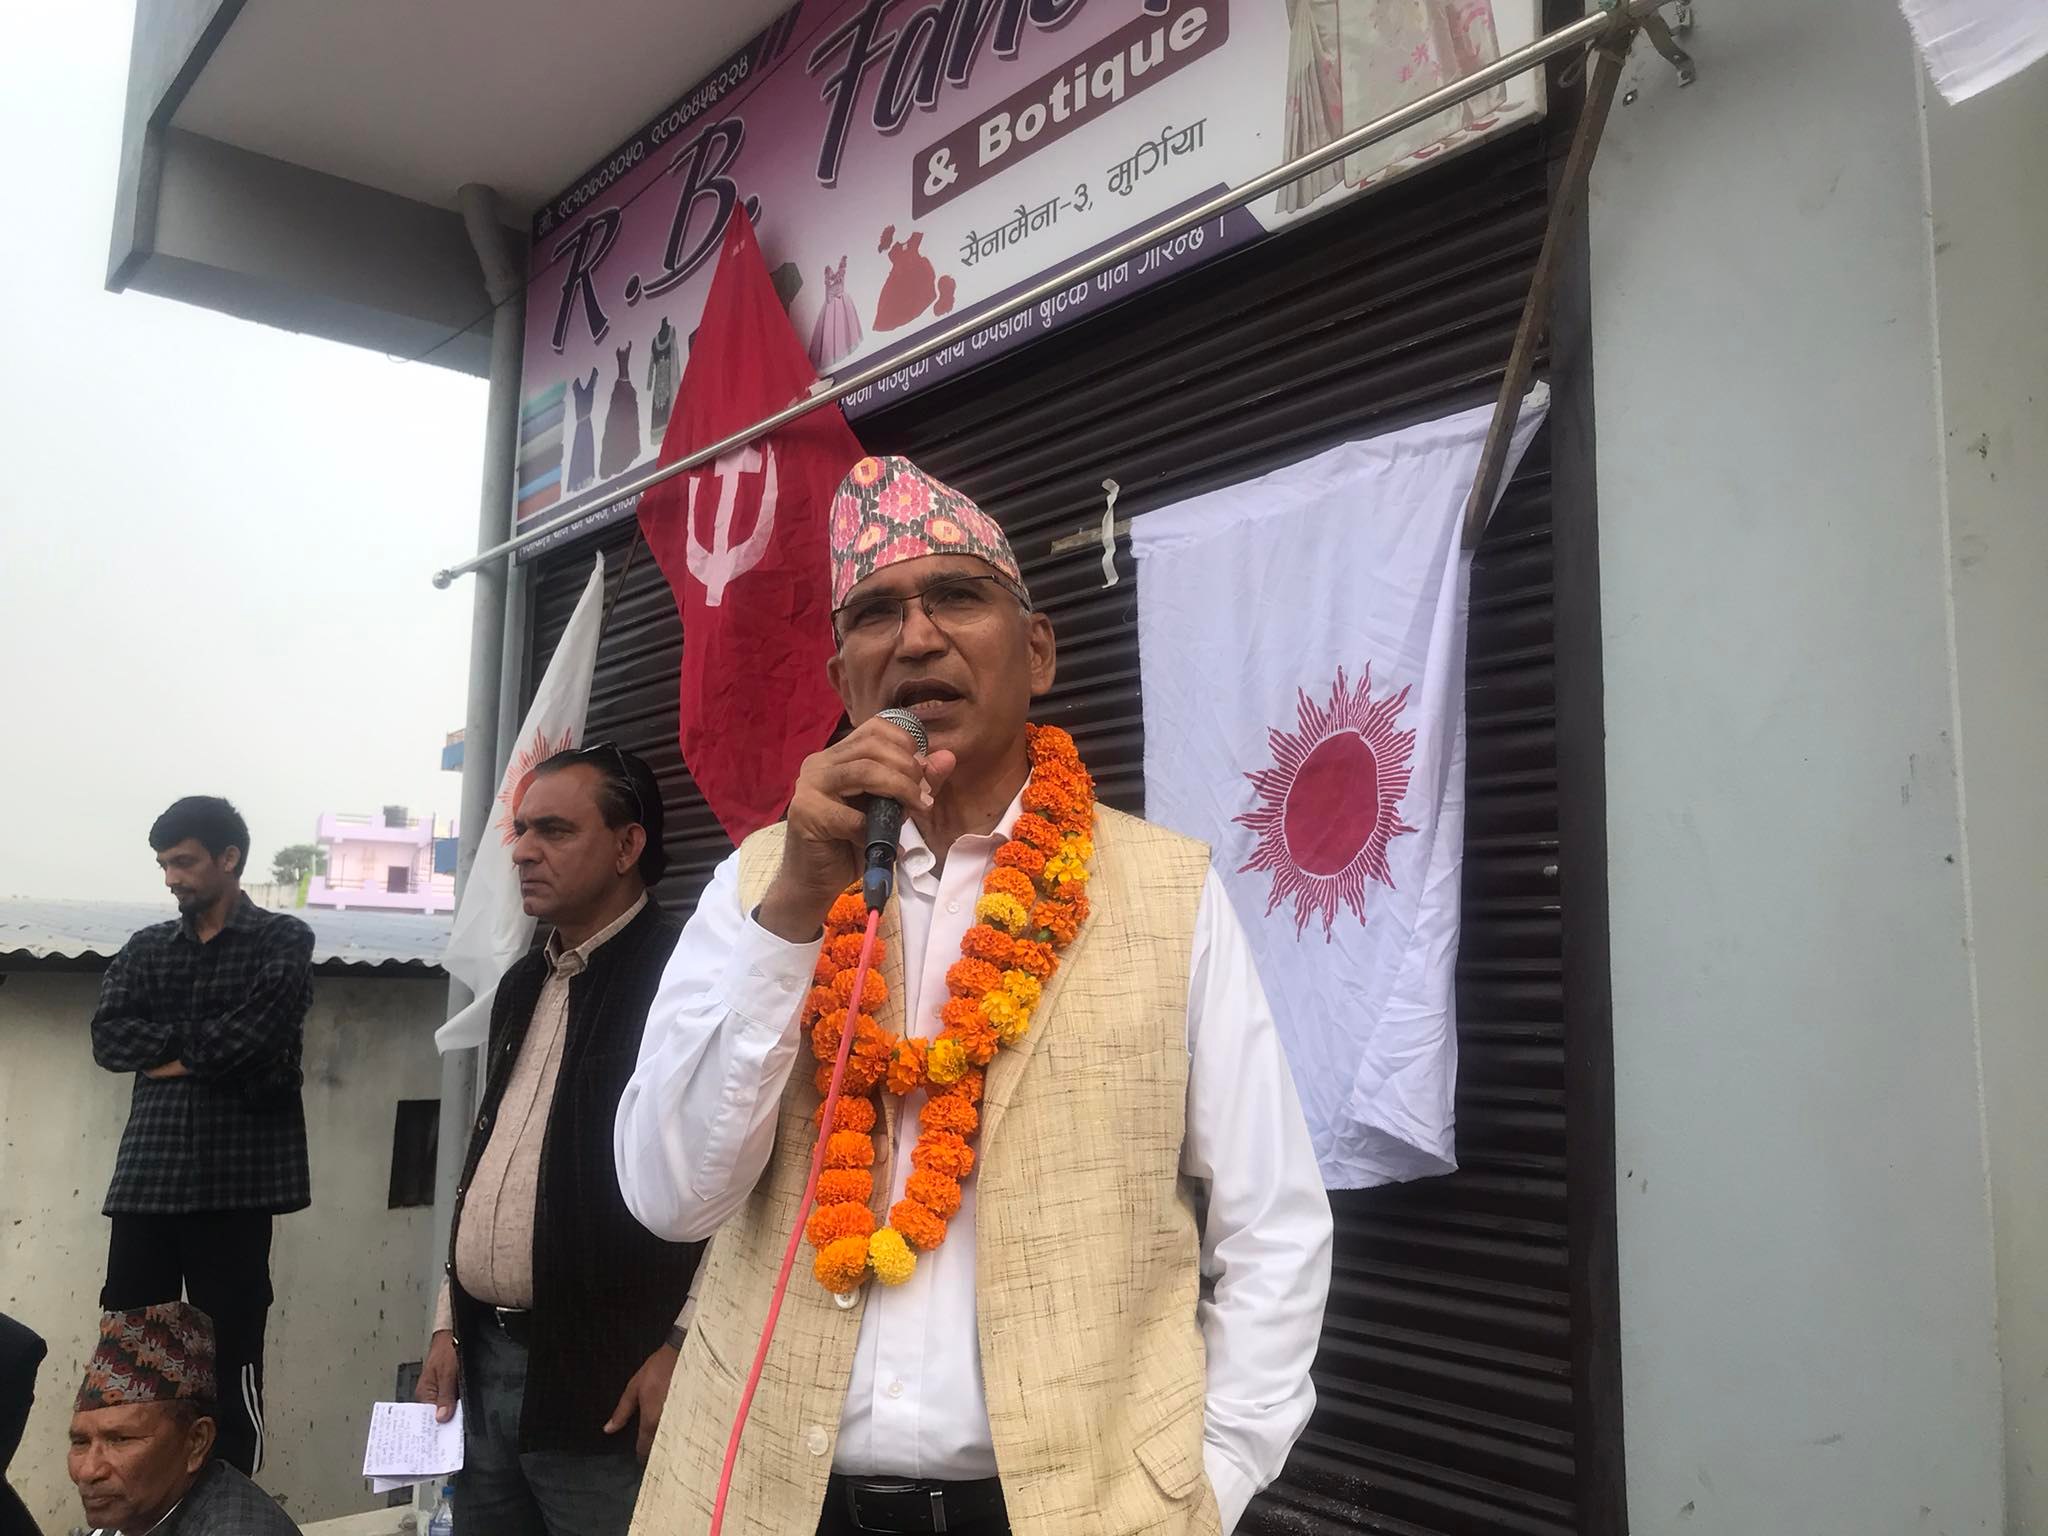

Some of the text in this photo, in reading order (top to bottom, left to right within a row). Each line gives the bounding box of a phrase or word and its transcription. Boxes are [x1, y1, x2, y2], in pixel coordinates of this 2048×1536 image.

[923, 5, 1209, 198] & Botique
[959, 183, 1095, 268] सैनामैना-३,
